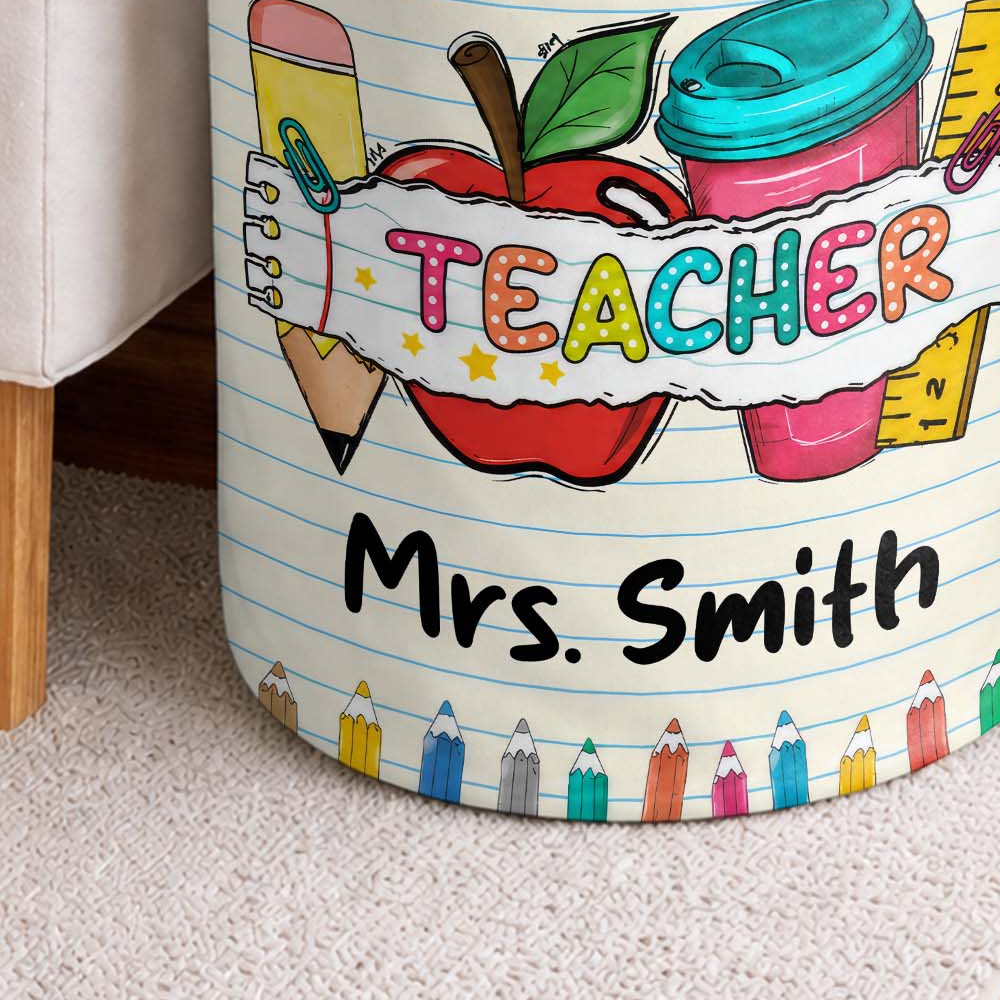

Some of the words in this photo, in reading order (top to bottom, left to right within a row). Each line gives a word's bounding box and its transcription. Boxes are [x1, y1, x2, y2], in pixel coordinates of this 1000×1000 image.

[384, 203, 955, 365] TEACHER
[918, 417, 948, 431] 1
[925, 377, 947, 401] 2
[343, 511, 582, 664] Mrs.
[616, 529, 940, 667] Smith
